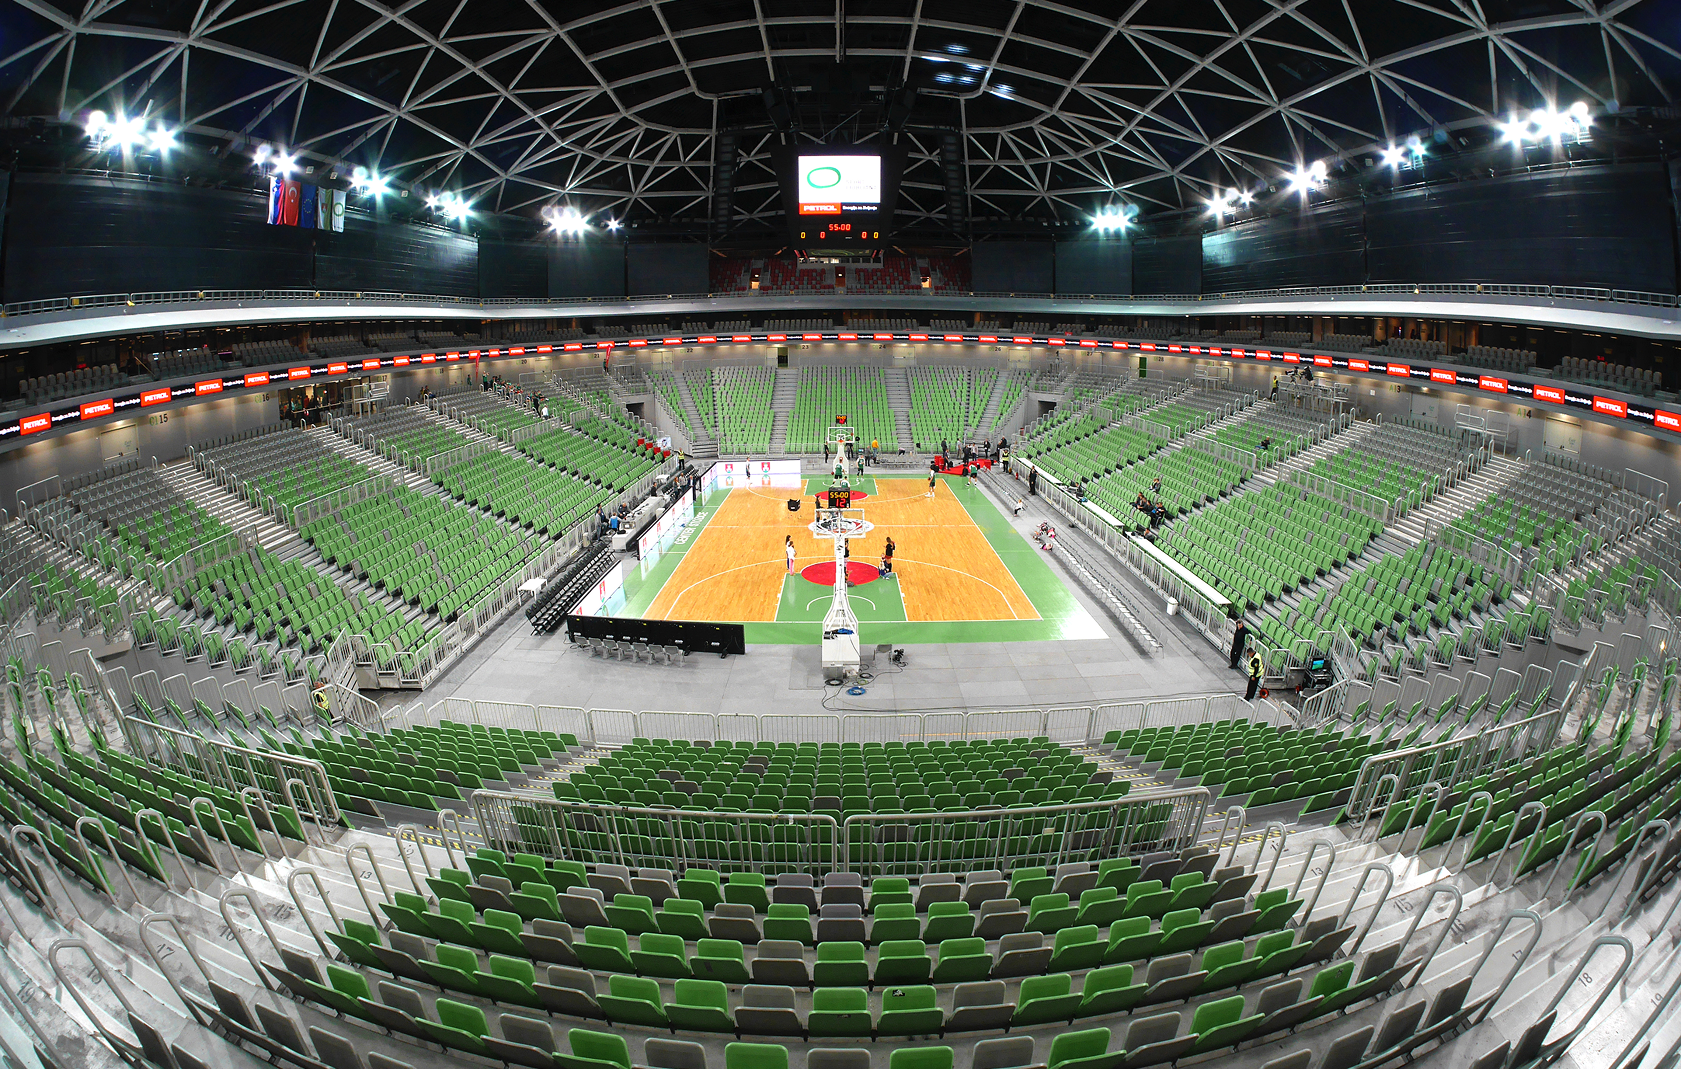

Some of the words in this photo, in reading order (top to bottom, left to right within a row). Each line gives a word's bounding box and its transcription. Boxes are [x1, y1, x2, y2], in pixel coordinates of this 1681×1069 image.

[820, 231, 826, 239] 0
[861, 231, 867, 239] 0
[291, 369, 309, 377] PETROL
[1388, 366, 1407, 374] PETROL
[248, 375, 267, 384] PETROL
[1432, 372, 1453, 381] PETROL
[199, 383, 220, 391] PETROL
[1481, 379, 1504, 389] PETROL
[145, 392, 168, 402] PETROL
[1536, 389, 1561, 399] PETROL
[84, 404, 110, 414] PETROL
[1596, 400, 1623, 413] PETROL
[24, 418, 48, 429] PETROL
[159, 413, 169, 424] 15
[1656, 415, 1680, 427] PETROL
[835, 498, 846, 508] 12
[360, 870, 373, 879] 13
[1310, 866, 1324, 877] 13
[1393, 897, 1414, 914] 15
[273, 903, 295, 920] 15
[156, 943, 175, 961] 17
[1578, 972, 1593, 988] 18
